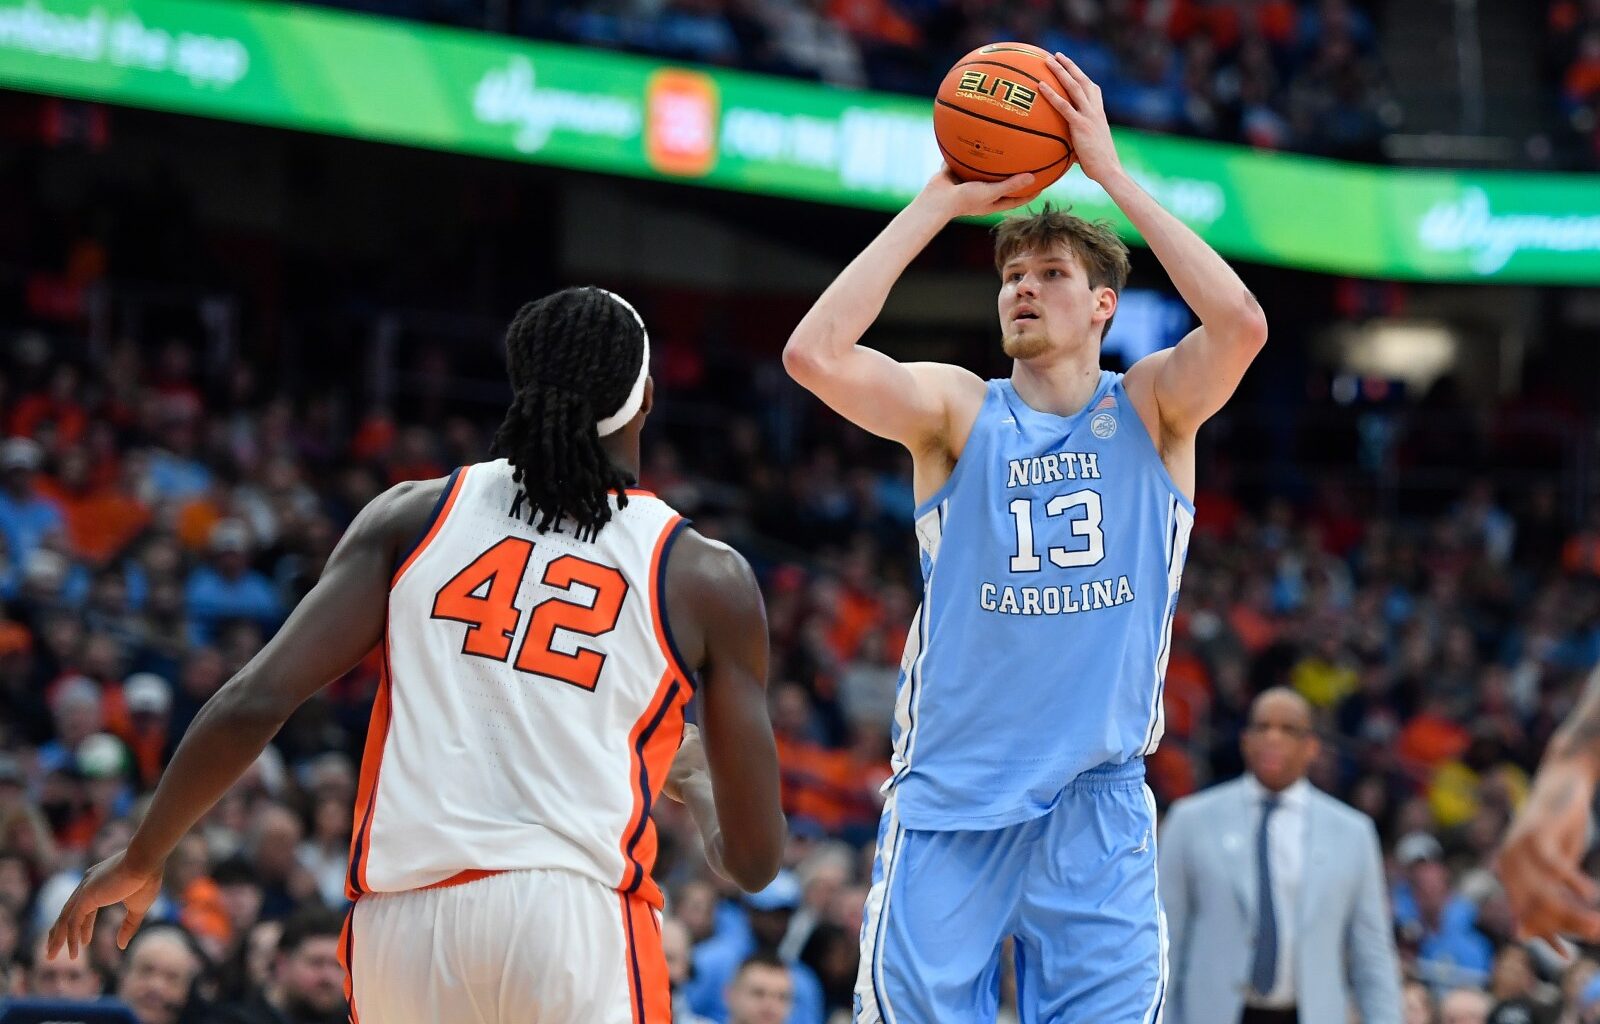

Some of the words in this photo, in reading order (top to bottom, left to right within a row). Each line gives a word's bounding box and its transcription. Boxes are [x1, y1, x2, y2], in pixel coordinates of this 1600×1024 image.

[957, 70, 1038, 112] ELITE
[1007, 452, 1101, 488] NORTH
[1009, 489, 1106, 573] 13
[430, 535, 630, 693] 42
[980, 575, 1135, 616] CAROLINA
